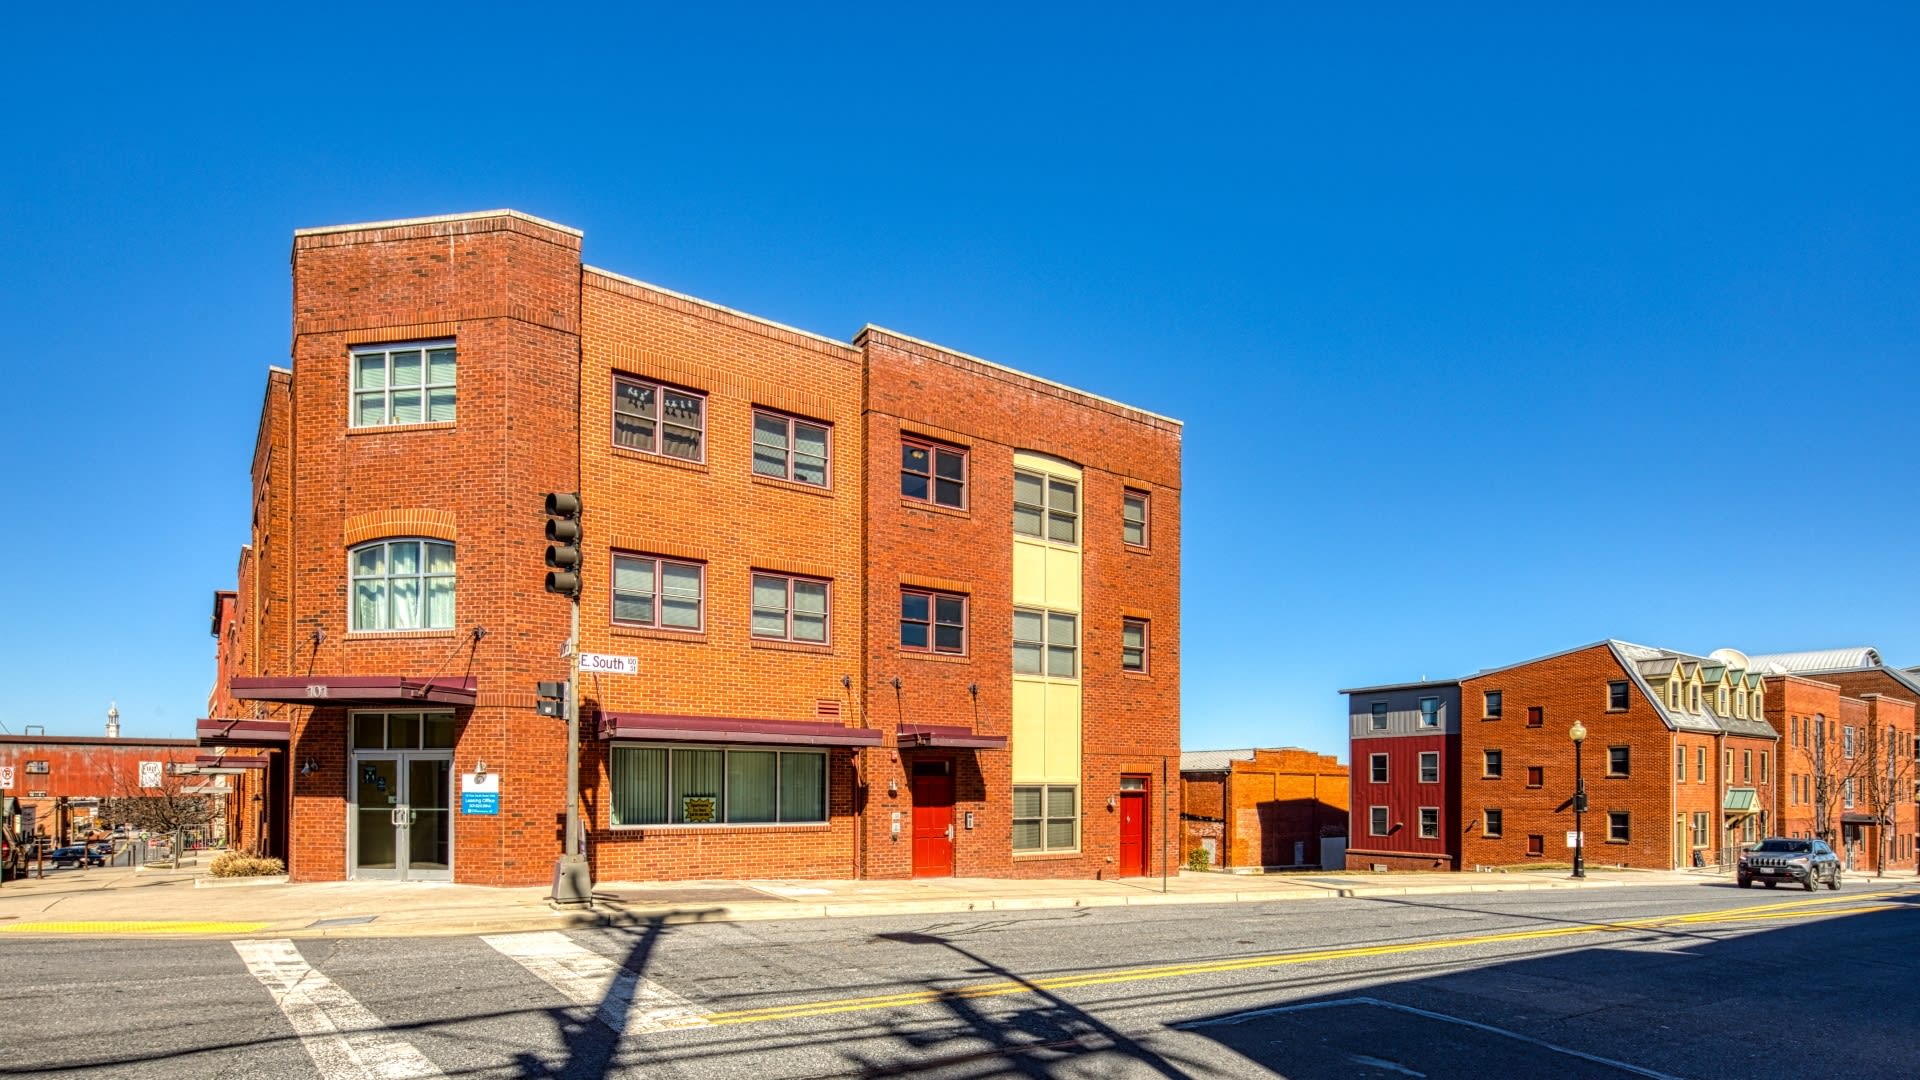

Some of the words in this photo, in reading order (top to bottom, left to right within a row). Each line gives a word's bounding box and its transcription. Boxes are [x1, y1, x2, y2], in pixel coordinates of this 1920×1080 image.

[581, 654, 590, 667] E.
[593, 655, 625, 671] South
[305, 685, 328, 698] 101
